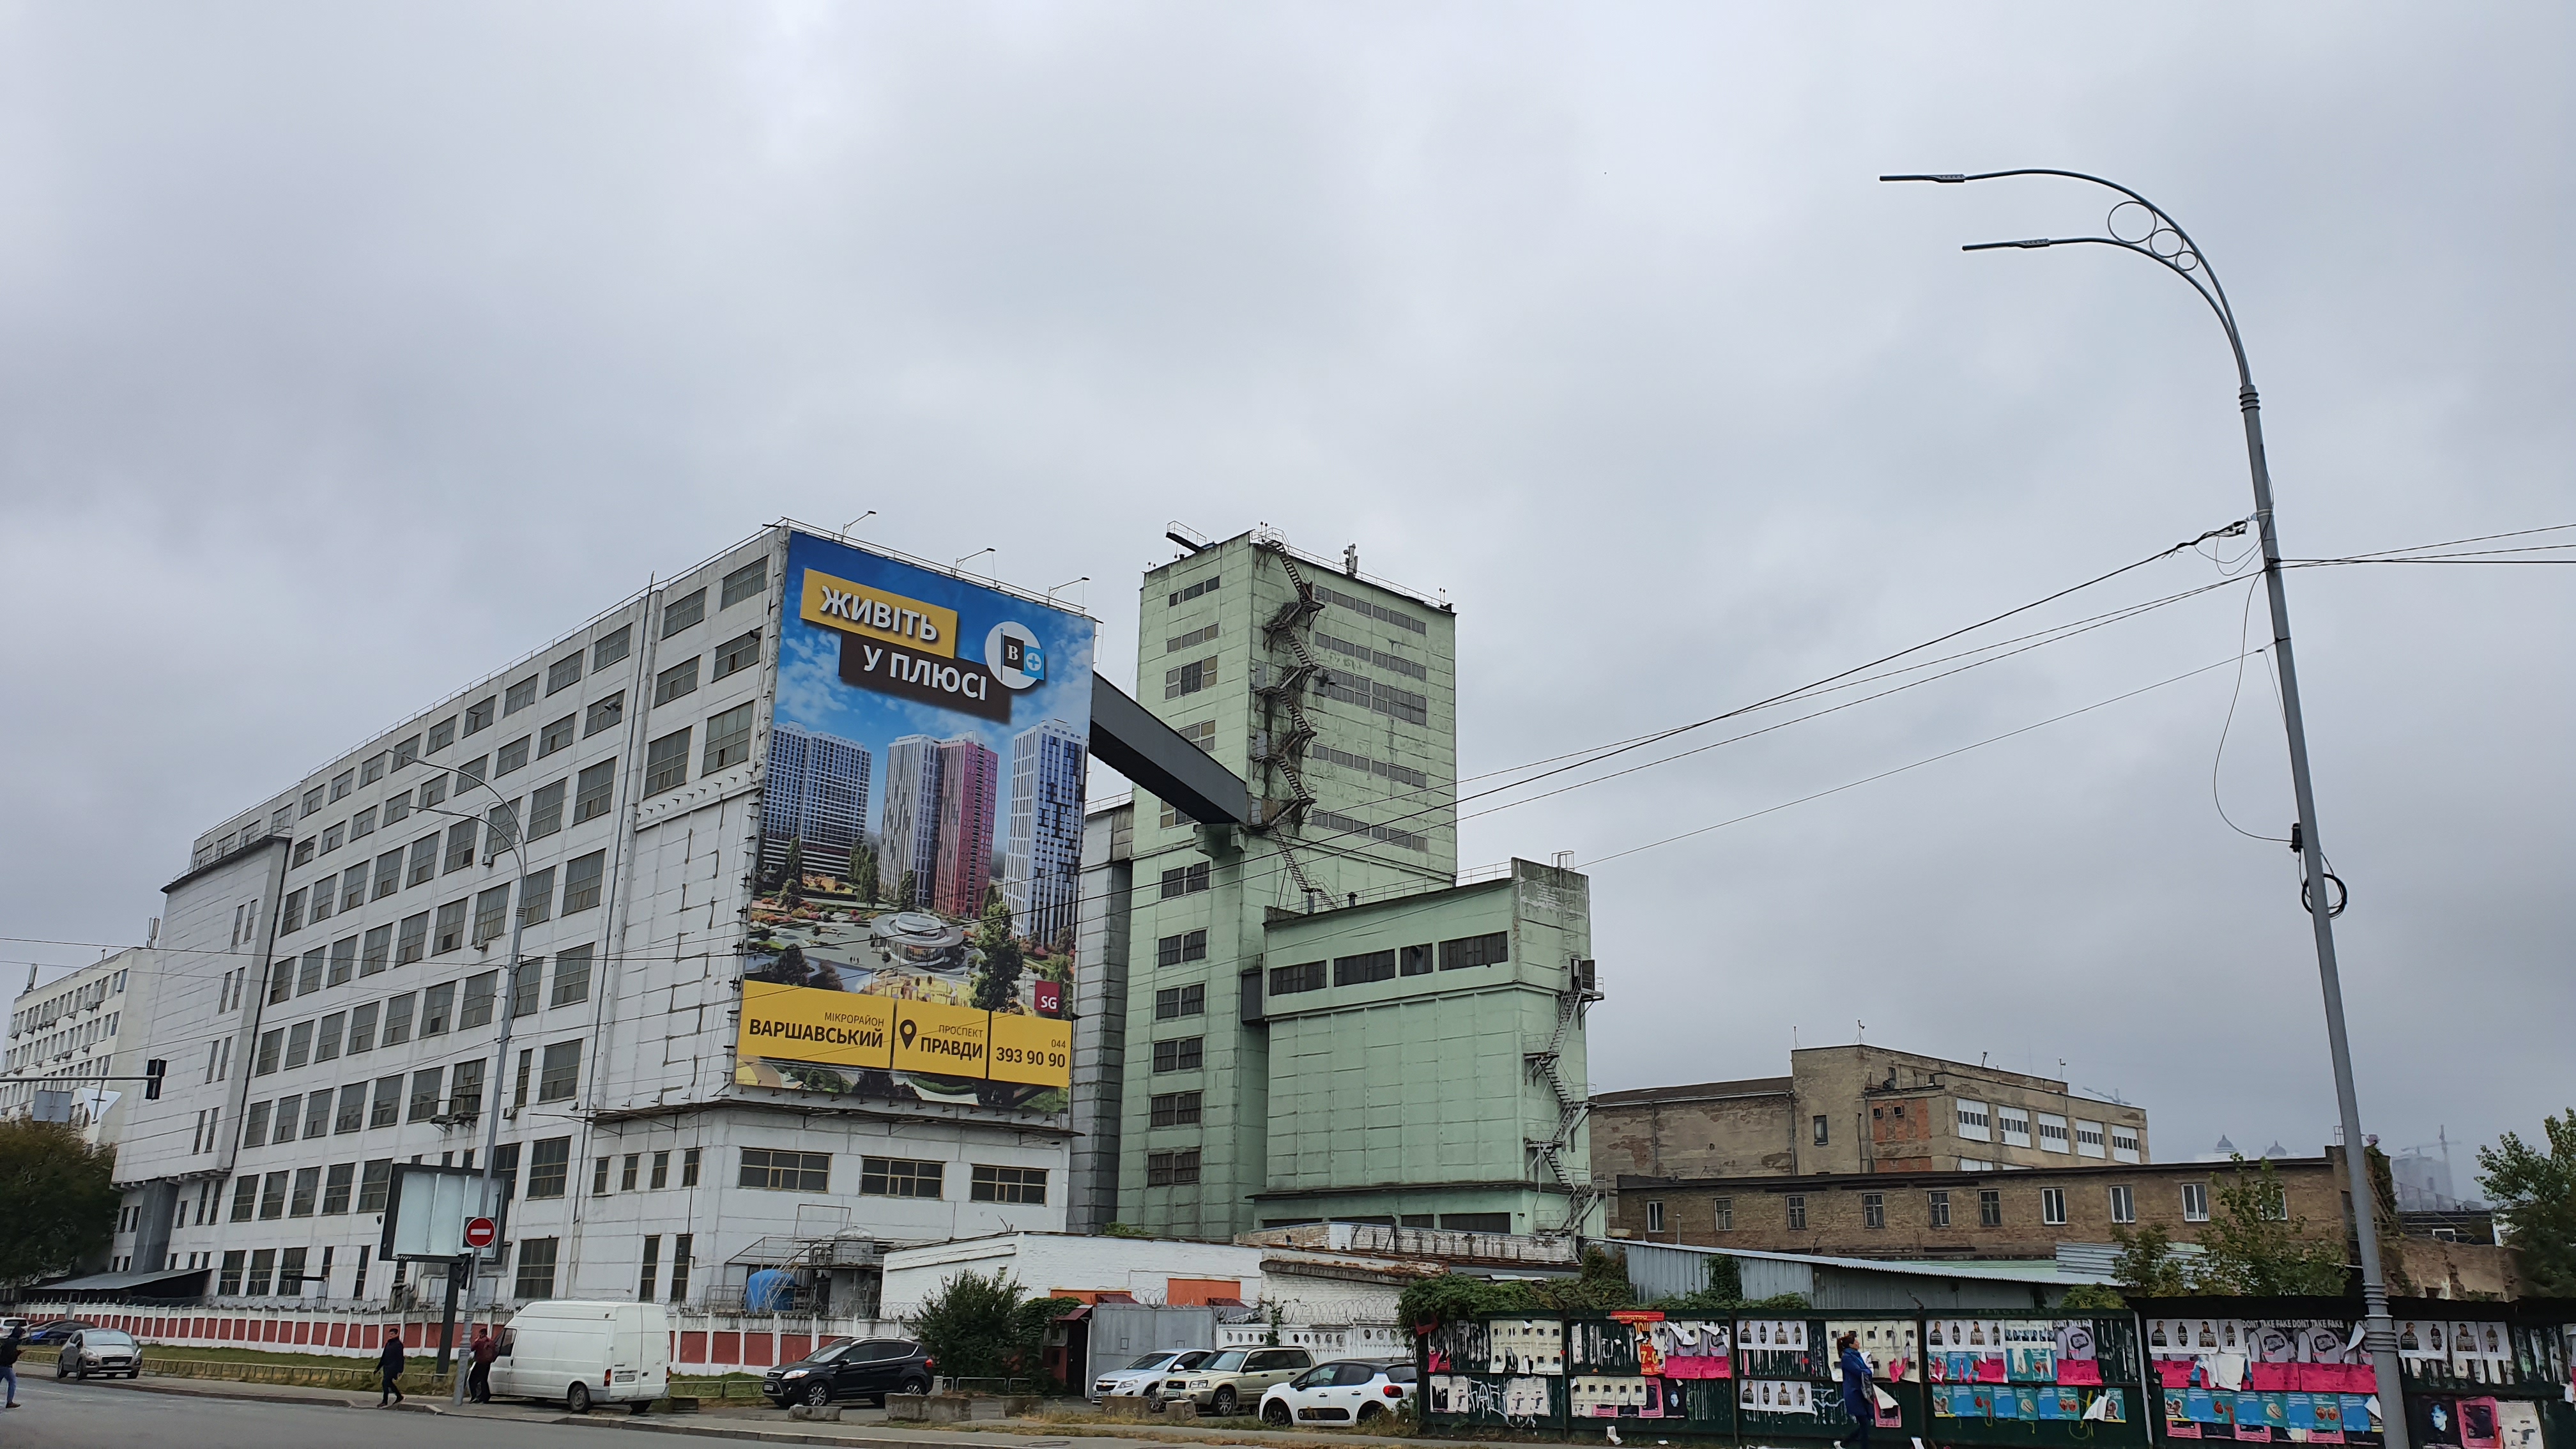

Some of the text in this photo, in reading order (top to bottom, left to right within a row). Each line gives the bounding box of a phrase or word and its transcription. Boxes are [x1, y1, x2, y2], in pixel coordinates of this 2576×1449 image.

[819, 585, 937, 641] ЖИВІТЬ
[863, 644, 986, 701] У ПЛЮСІ
[1041, 995, 1057, 1009] SG
[824, 1011, 884, 1027] МІКРОРАЙОН
[749, 1018, 884, 1048] ВАРШАВСЬКИЙ
[939, 1024, 983, 1038] ПРОСПЕКТ
[920, 1037, 983, 1061] ПРАВДИ
[1051, 1039, 1066, 1048] 044
[995, 1047, 1066, 1068] 393 90 90
